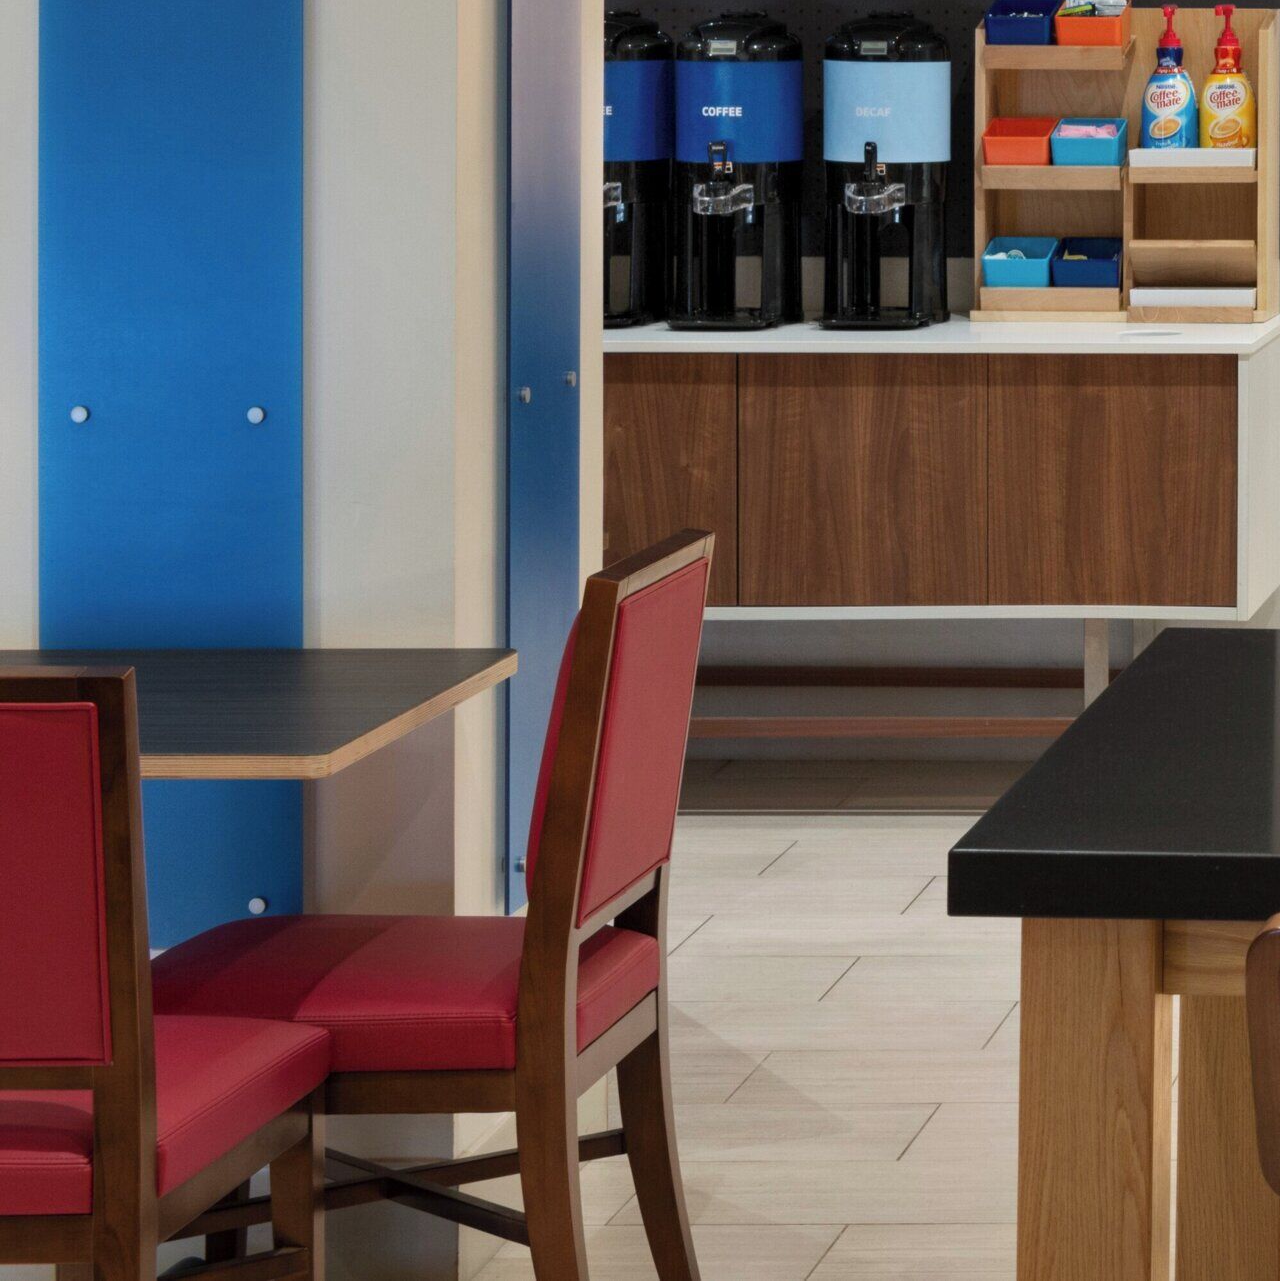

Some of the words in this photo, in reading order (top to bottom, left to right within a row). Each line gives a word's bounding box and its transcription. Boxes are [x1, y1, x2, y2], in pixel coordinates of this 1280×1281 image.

[1150, 89, 1179, 103] Coffee
[1156, 96, 1181, 109] mate
[1209, 89, 1238, 103] Coffee
[1216, 96, 1241, 109] mate
[702, 106, 743, 117] COFFEE
[855, 106, 892, 117] DECAF
